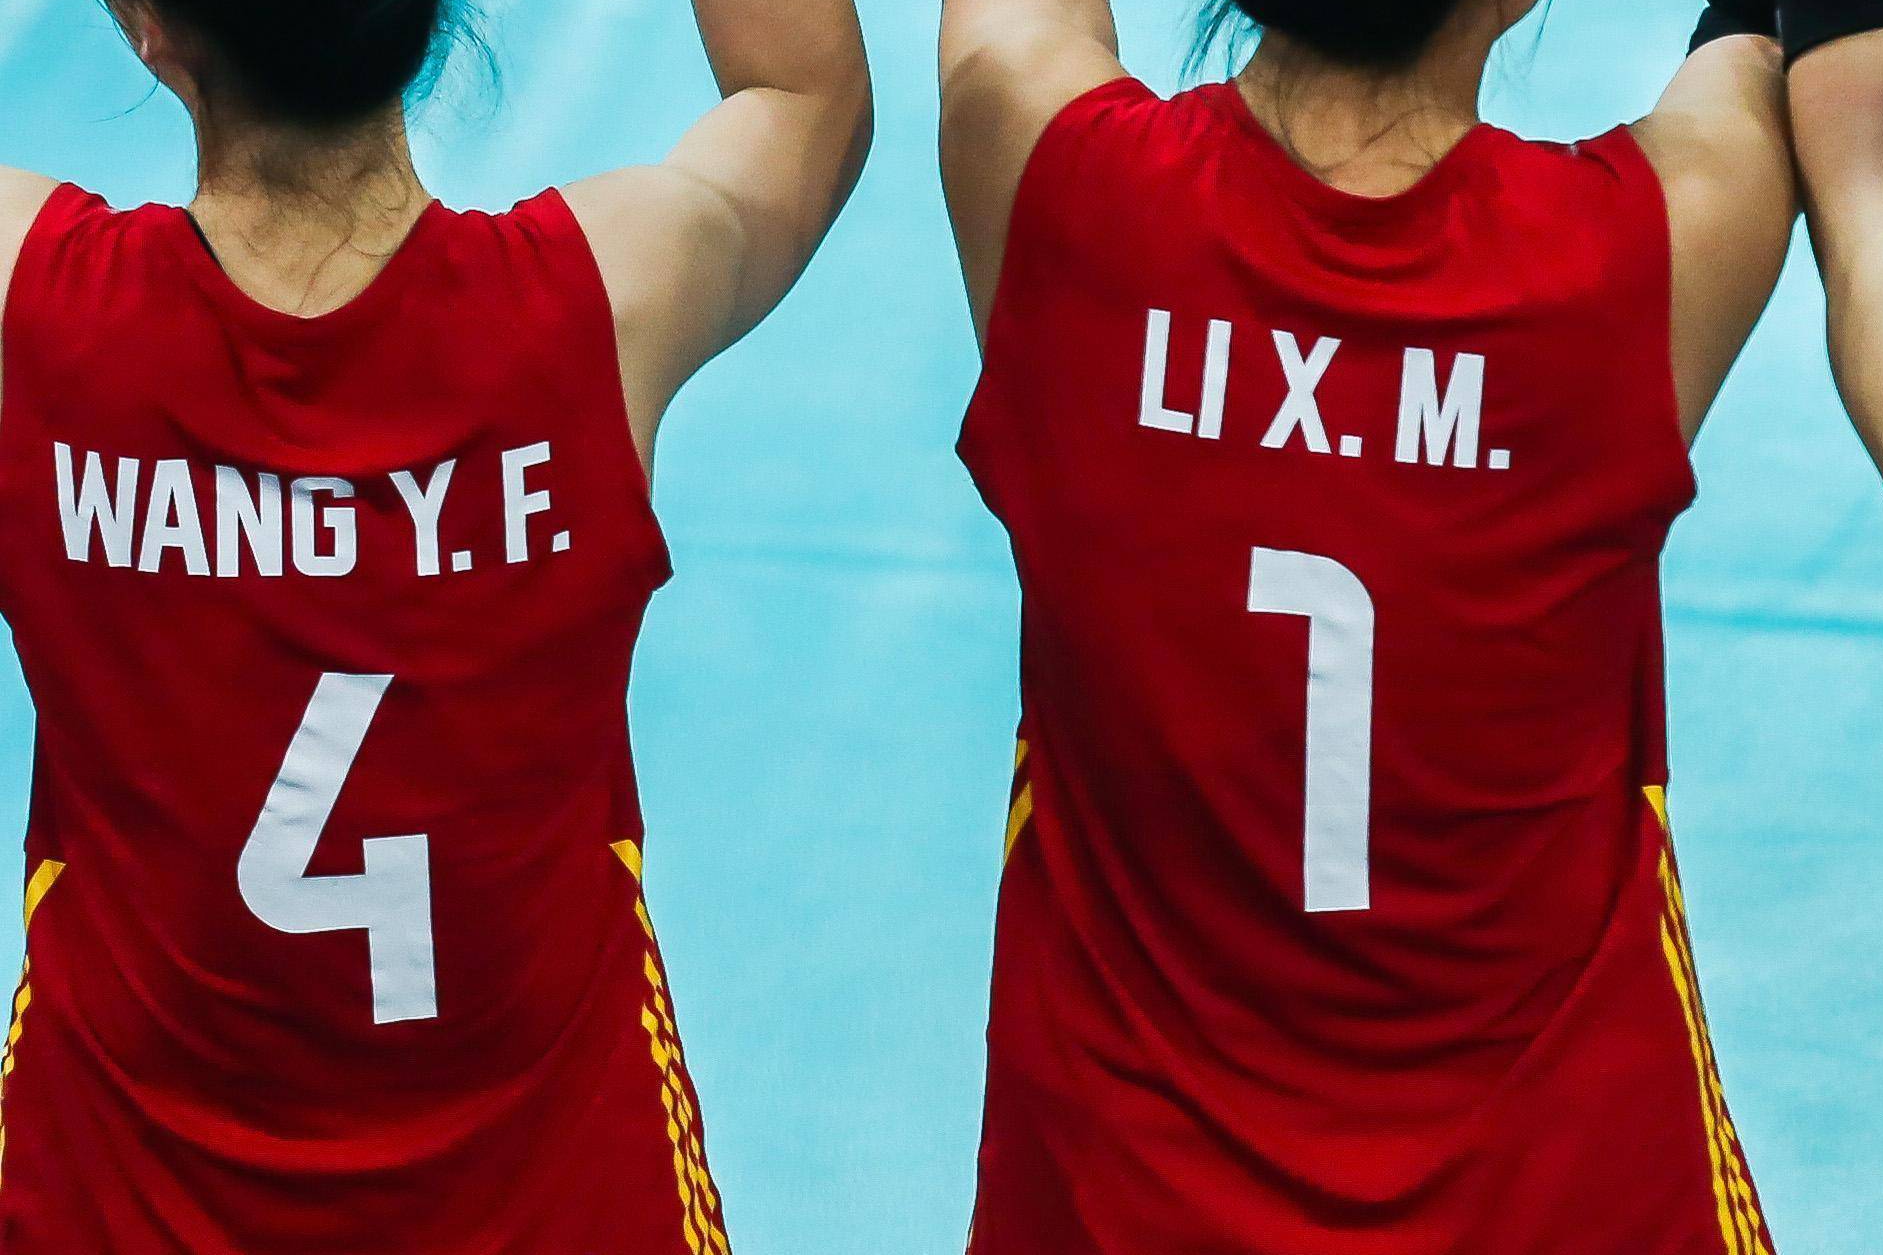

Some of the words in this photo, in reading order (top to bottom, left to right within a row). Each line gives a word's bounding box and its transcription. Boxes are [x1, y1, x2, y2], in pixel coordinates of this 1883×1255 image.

[53, 440, 358, 578] WANG
[388, 458, 472, 577] Y.
[501, 440, 571, 565] F.
[1138, 308, 1232, 440] LI
[1259, 328, 1363, 457] X.
[1394, 346, 1511, 469] M.
[236, 671, 438, 1025] 4
[1246, 545, 1375, 913] 1
